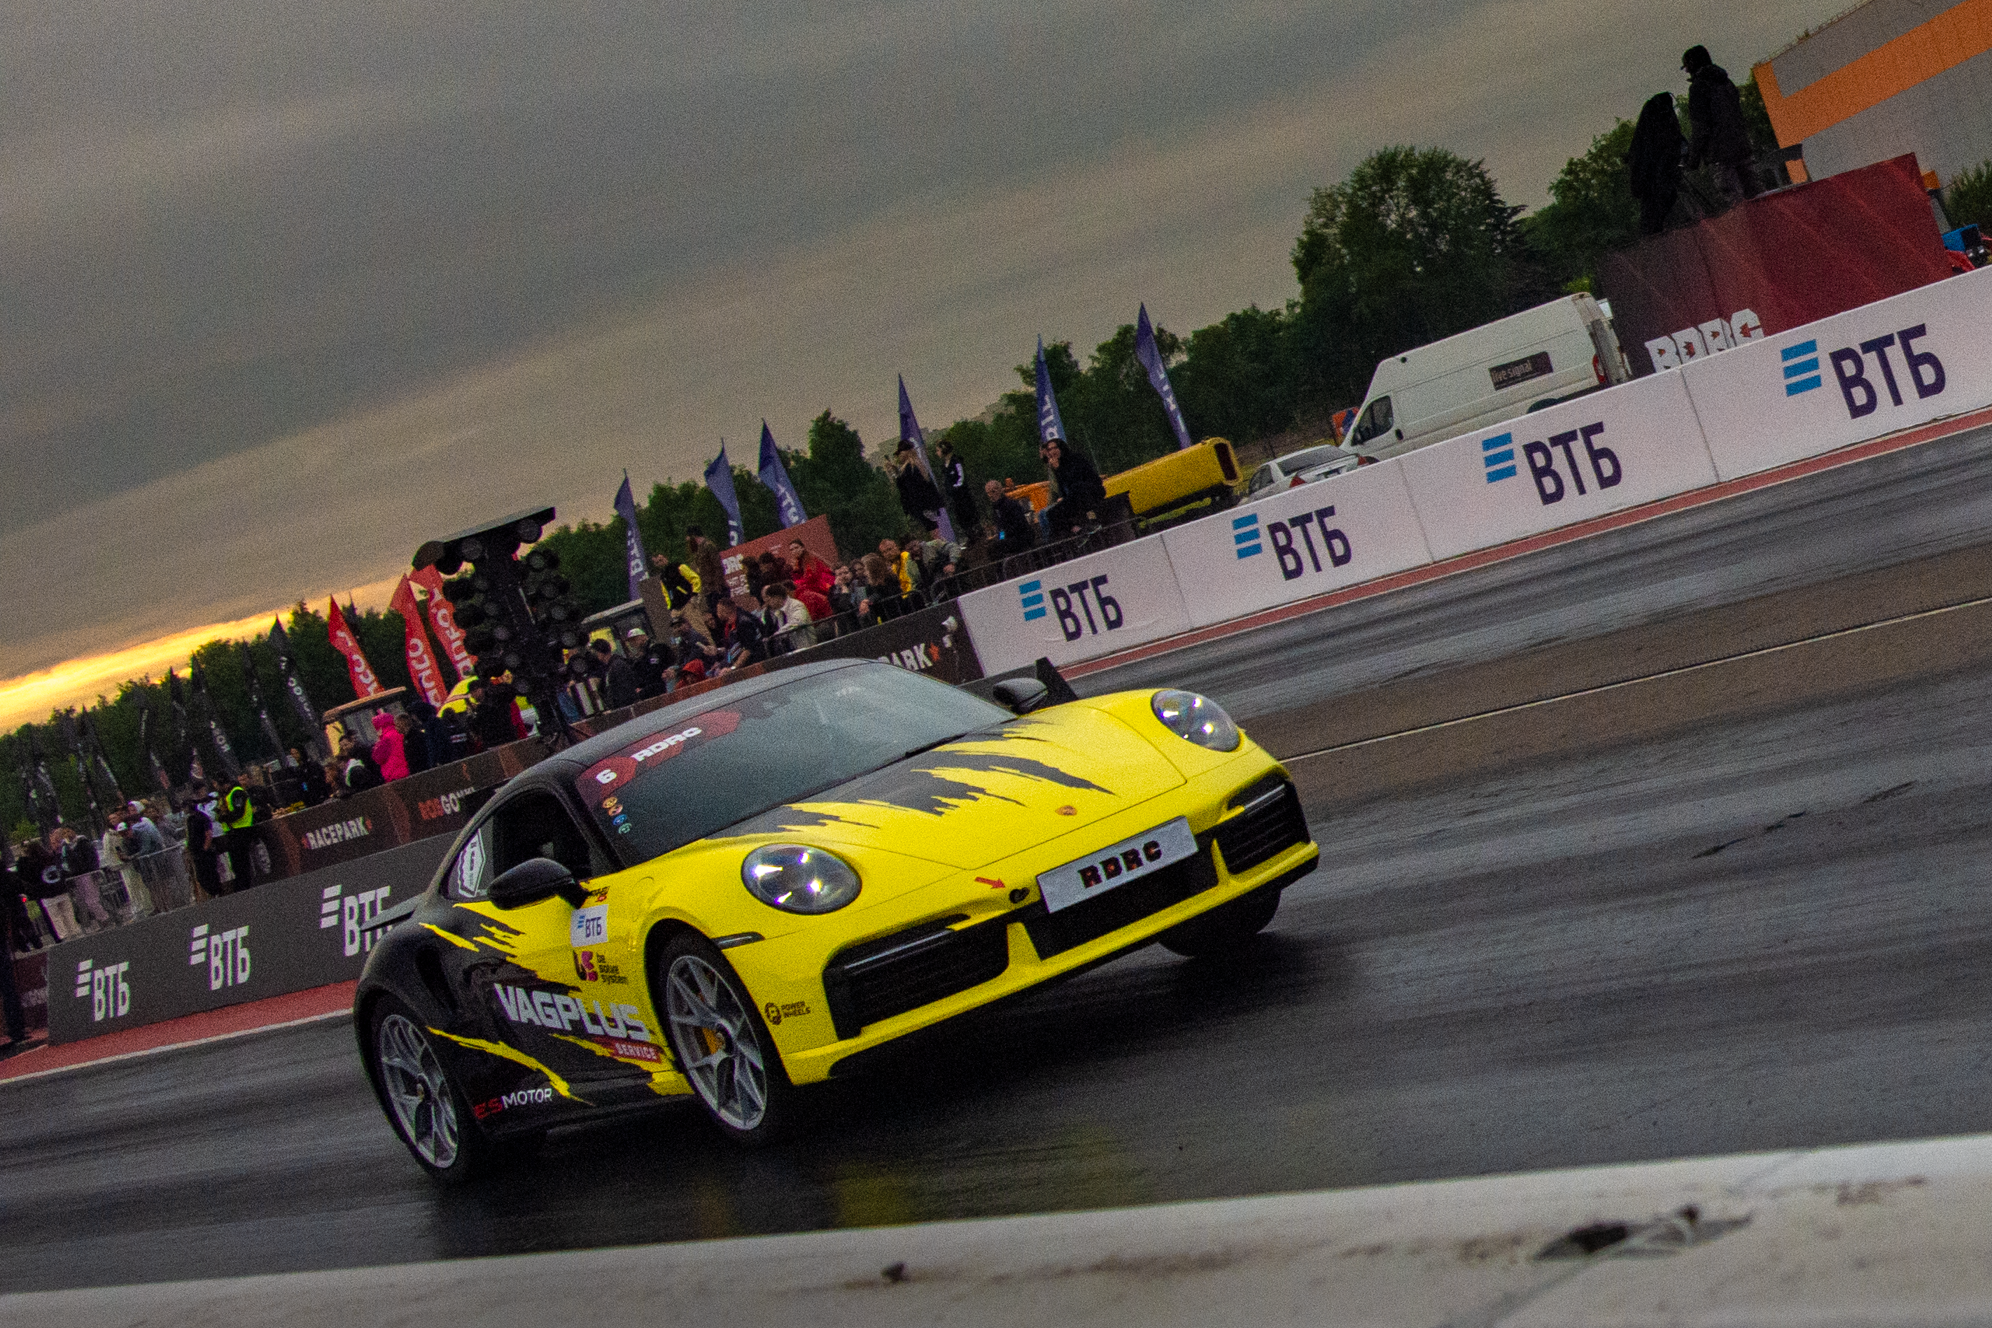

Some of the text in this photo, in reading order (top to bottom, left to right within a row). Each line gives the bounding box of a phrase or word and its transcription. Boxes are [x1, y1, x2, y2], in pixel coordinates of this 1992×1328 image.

[1828, 323, 1946, 419] ВТБ
[1522, 421, 1622, 505] ВТБ
[1267, 505, 1352, 580] ВТБ
[1049, 574, 1123, 641] ВТБ
[595, 768, 617, 784] 6
[306, 816, 370, 849] RACEPARK
[1078, 840, 1162, 888] RDRC
[585, 916, 602, 938] ВТБ
[208, 925, 252, 991] ВТБ
[92, 961, 131, 1022] ВТБ
[494, 982, 653, 1041] VAGPLUS
[781, 1000, 806, 1011] POWER
[615, 1043, 658, 1060] SERVICE
